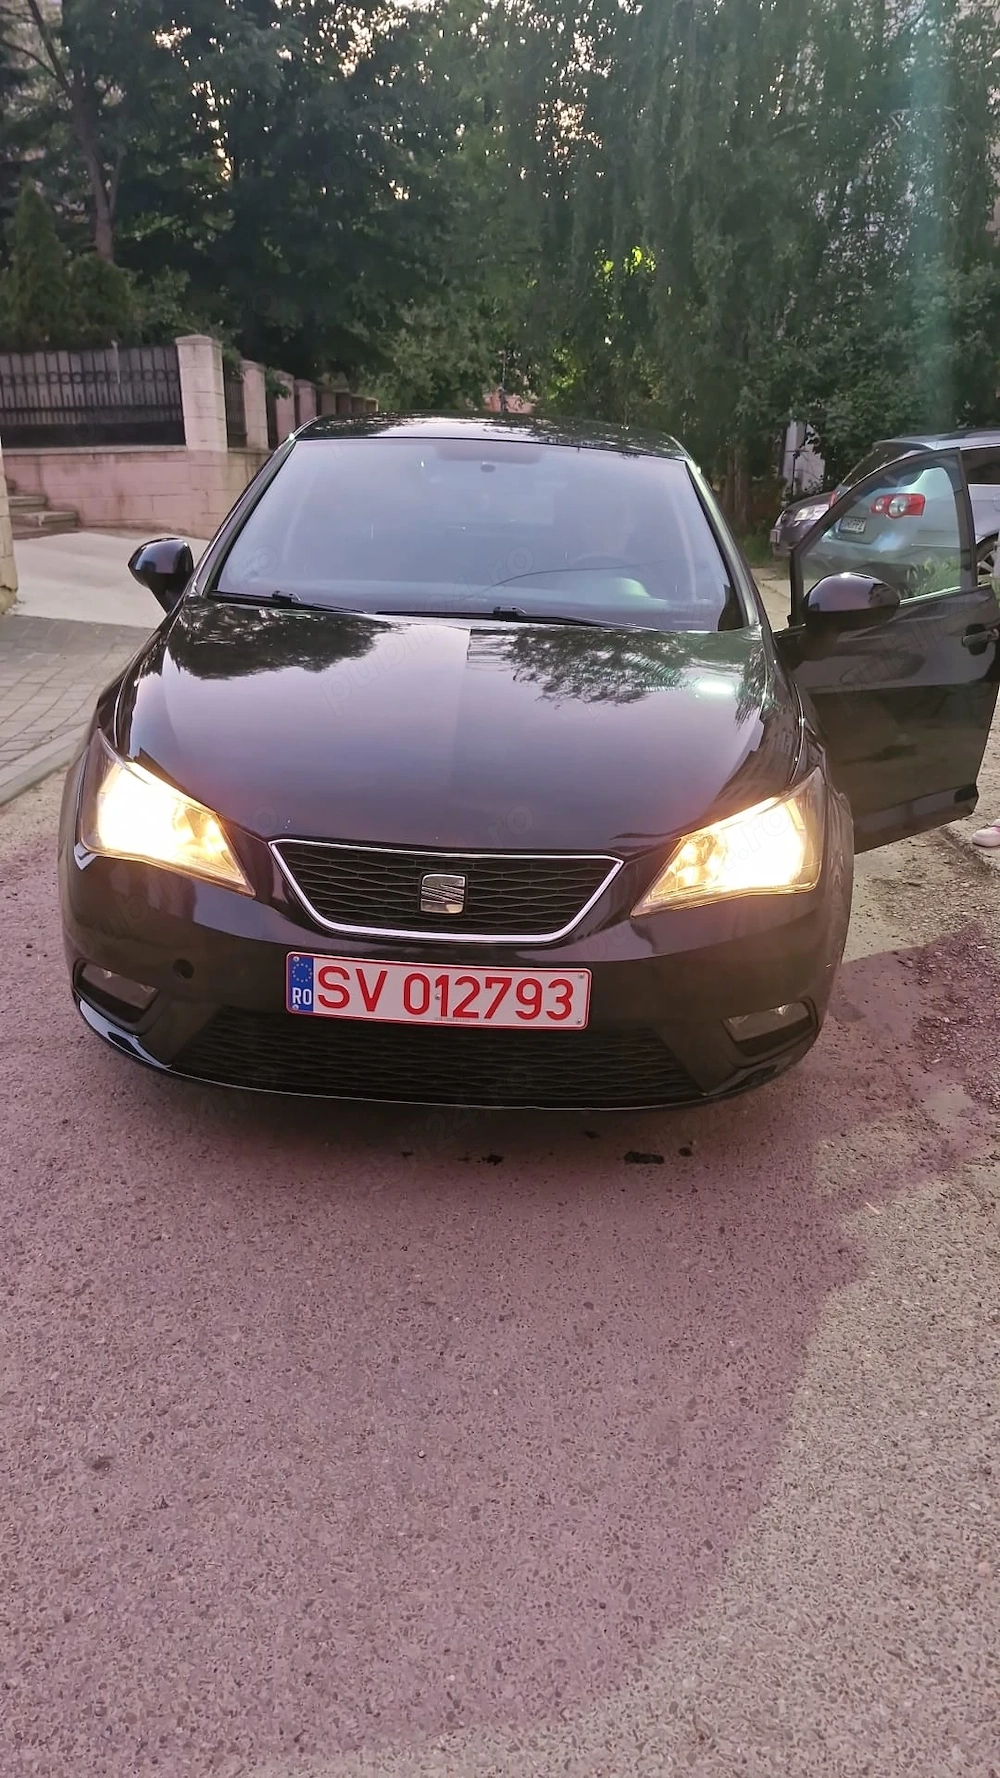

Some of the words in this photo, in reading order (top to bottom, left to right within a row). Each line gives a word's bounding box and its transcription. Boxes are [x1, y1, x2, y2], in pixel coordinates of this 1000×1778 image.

[292, 987, 312, 1005] RO
[317, 965, 388, 1012] SV
[403, 973, 574, 1021] 012793
